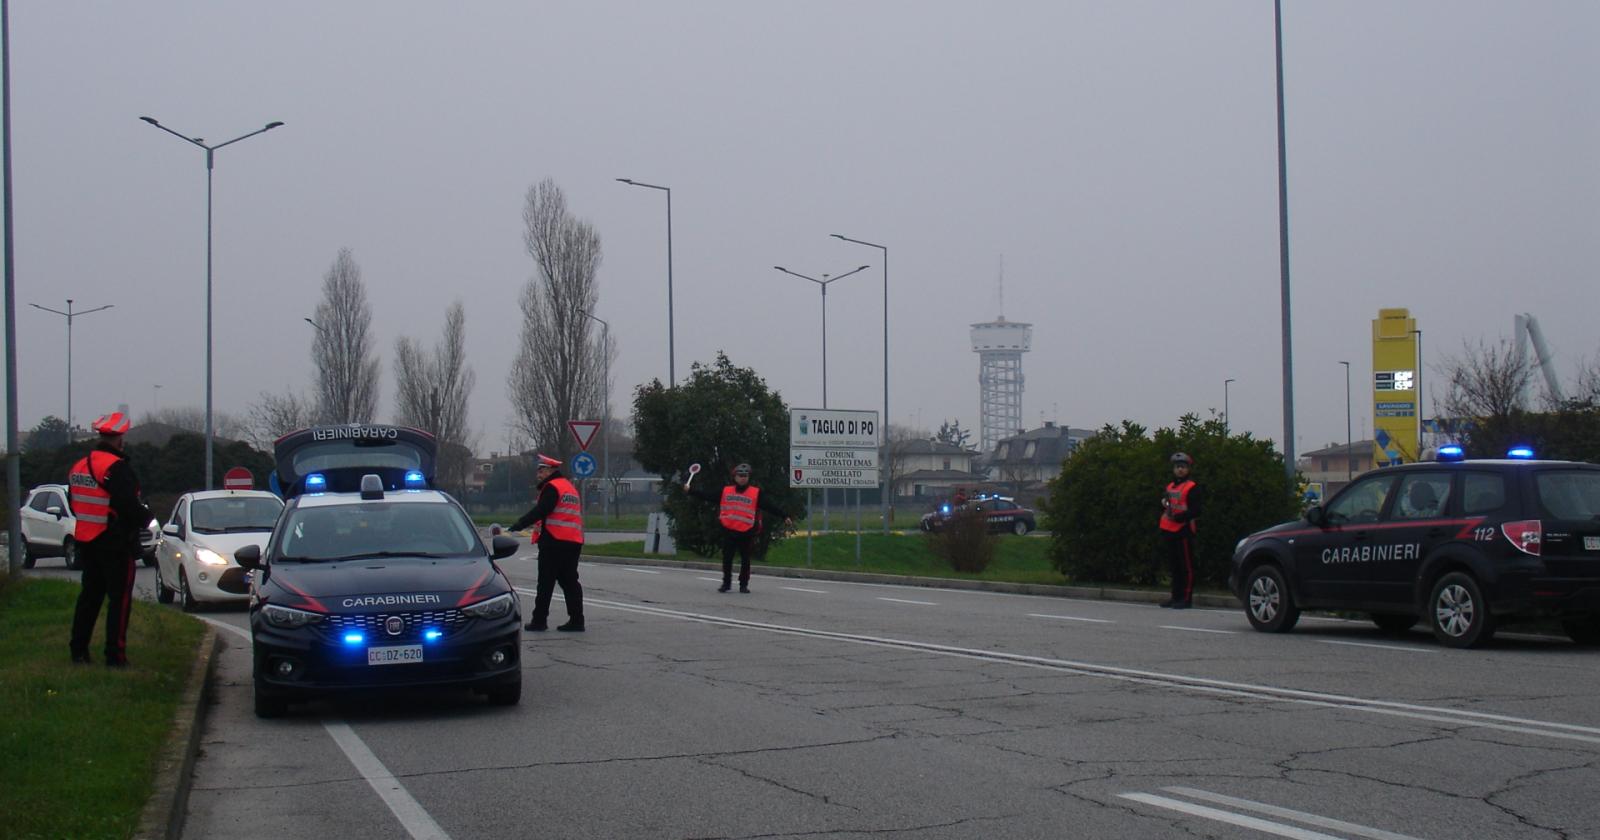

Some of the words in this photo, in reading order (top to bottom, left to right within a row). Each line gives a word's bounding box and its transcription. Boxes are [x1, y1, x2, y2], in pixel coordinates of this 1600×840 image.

[812, 419, 844, 435] TAGLIO
[848, 420, 858, 435] DI
[861, 421, 874, 436] PO
[313, 428, 398, 441] CARABINIERI
[825, 451, 855, 459] COMUNE
[807, 458, 852, 466] REGISTRATO
[853, 459, 872, 467] EMAS
[821, 470, 862, 478] GEMELLATO
[806, 477, 821, 485] CON
[1474, 527, 1495, 542] 112
[1321, 543, 1421, 564] CARABINIERI
[342, 594, 441, 608] CARABINIERI
